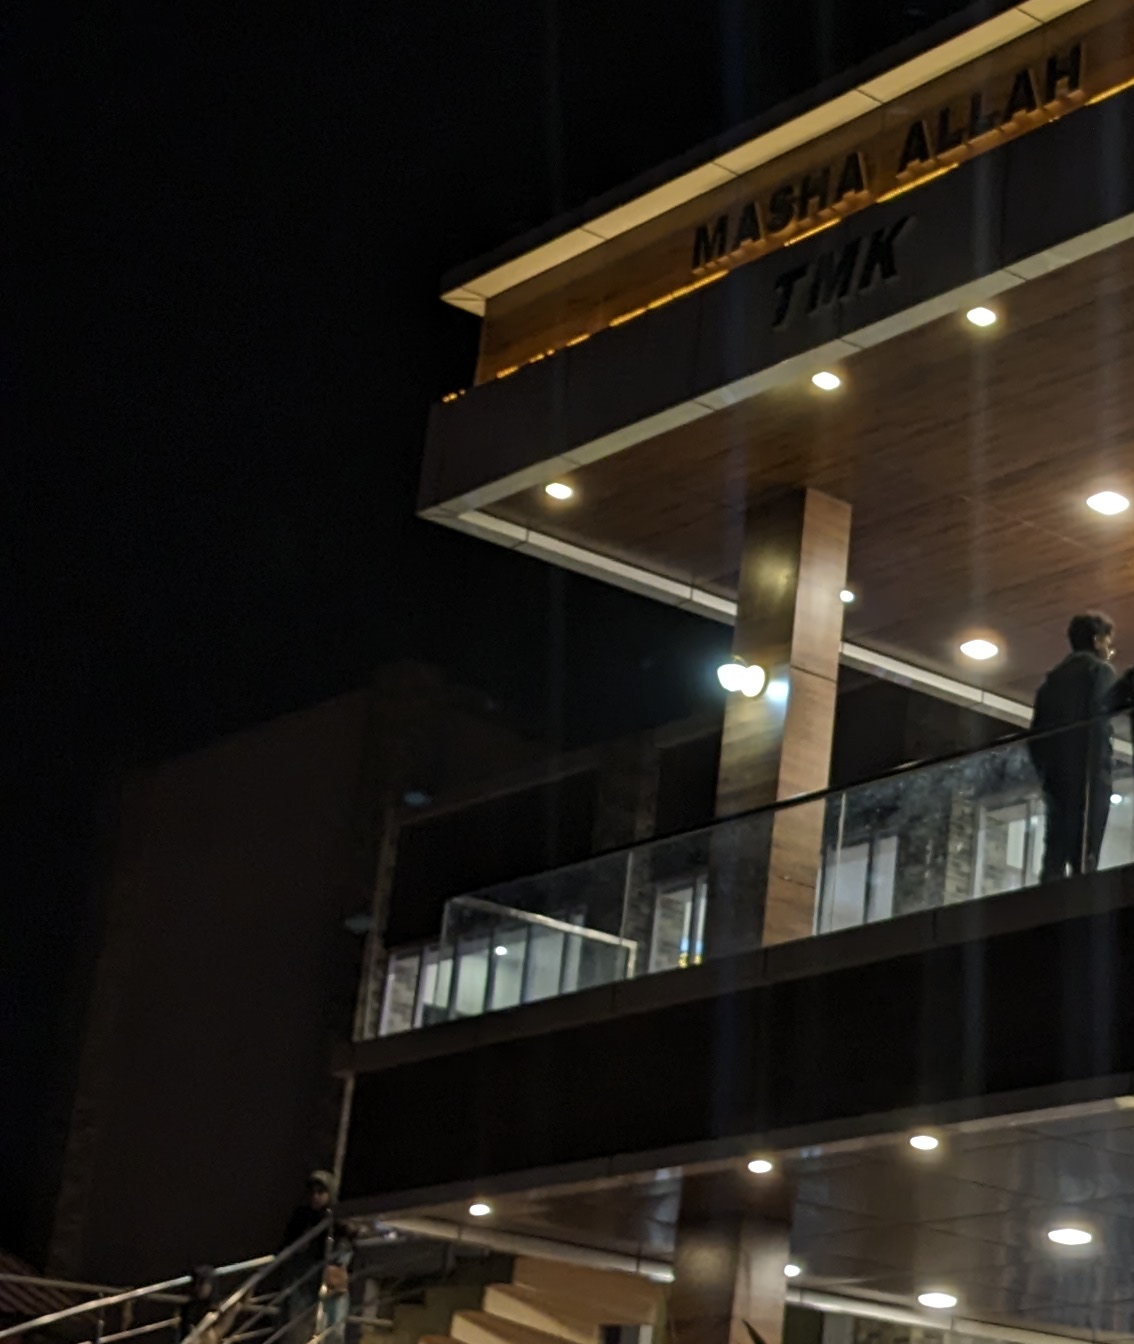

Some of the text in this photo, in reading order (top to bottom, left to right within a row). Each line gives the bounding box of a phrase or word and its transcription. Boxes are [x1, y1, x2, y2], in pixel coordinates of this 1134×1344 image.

[691, 43, 1084, 271] MASHA ALLAH
[772, 216, 912, 330] TMK
